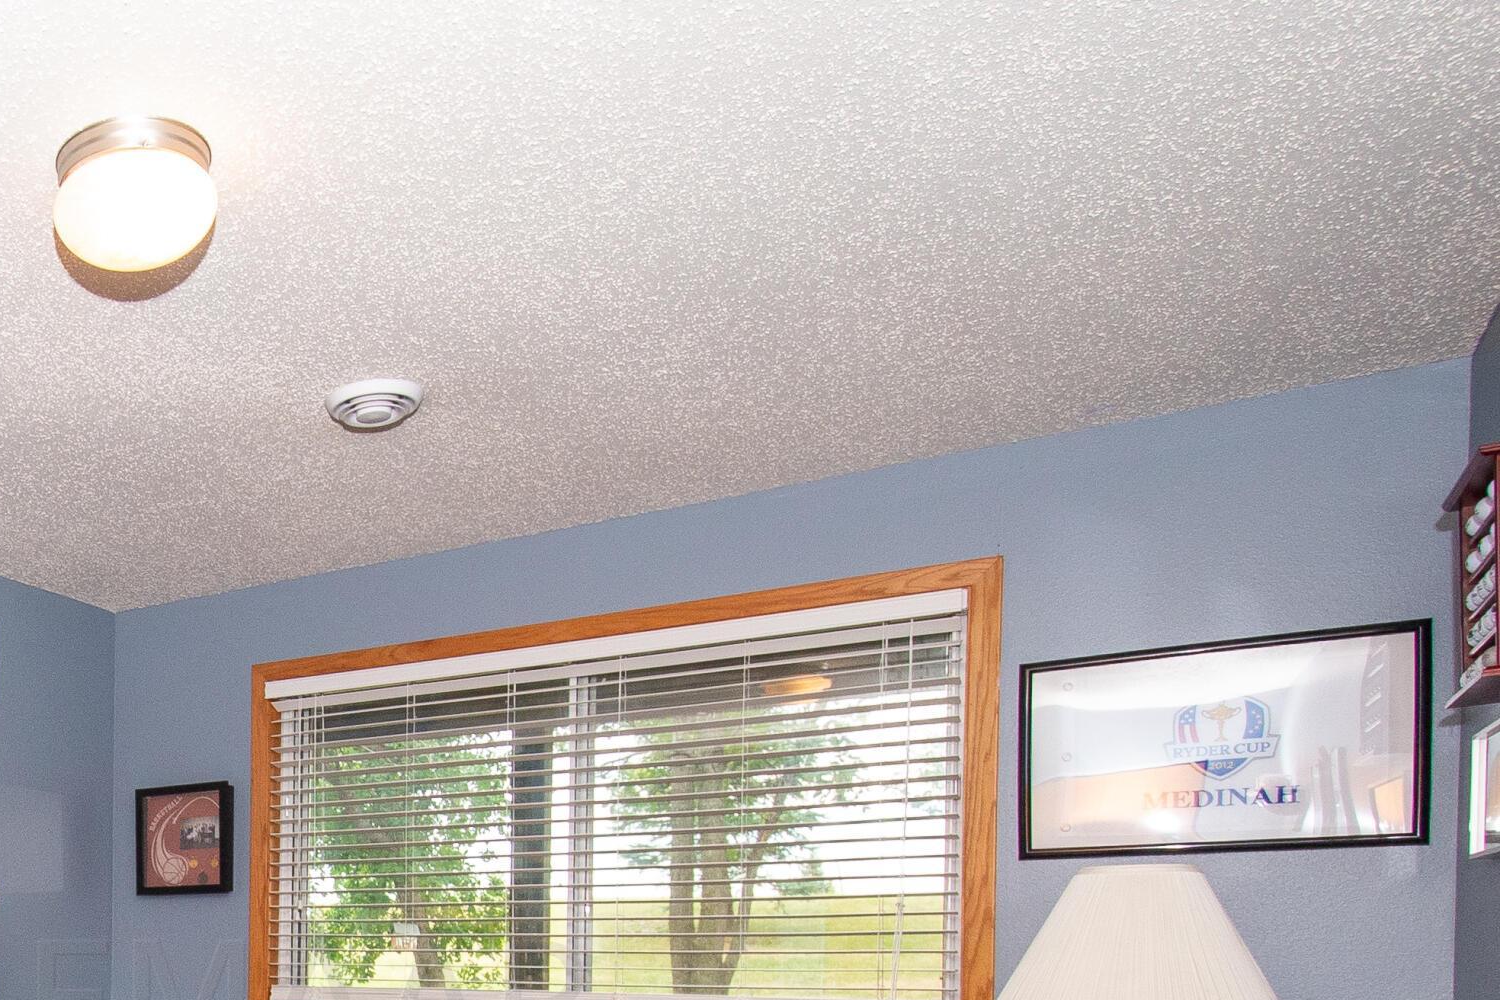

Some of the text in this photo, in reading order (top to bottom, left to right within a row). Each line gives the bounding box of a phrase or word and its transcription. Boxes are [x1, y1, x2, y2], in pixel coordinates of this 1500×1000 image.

[1172, 742, 1271, 758] RYDER CUP
[1142, 784, 1301, 810] MEDINAH
